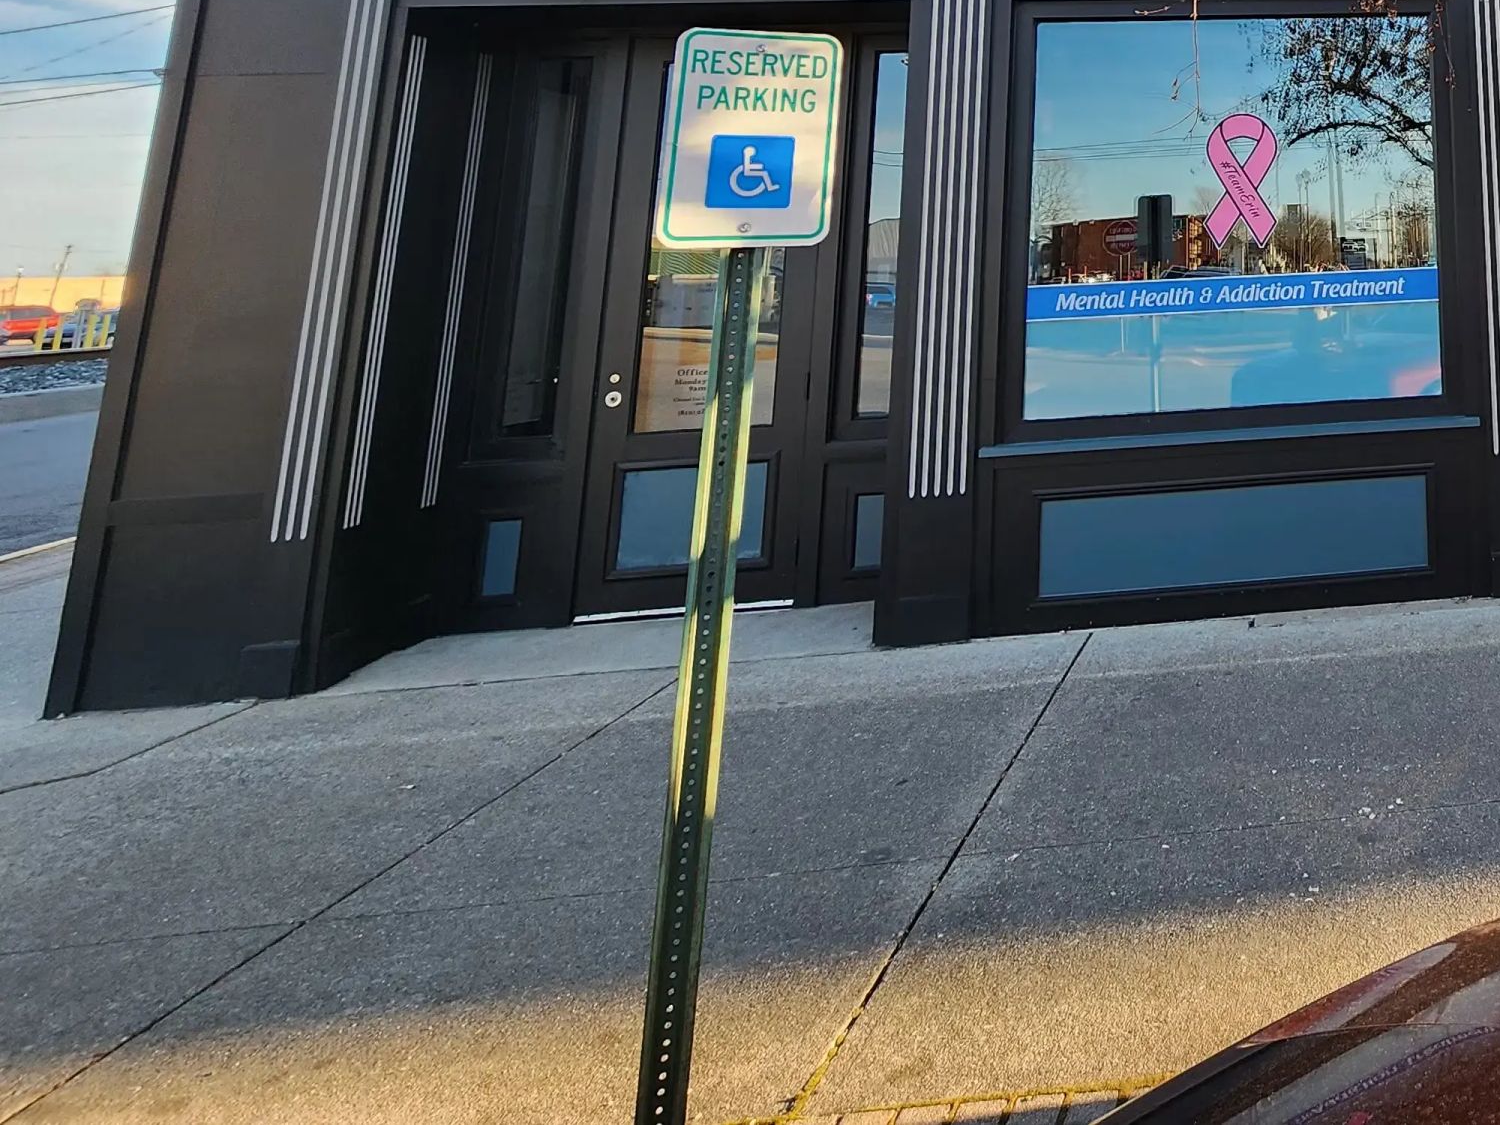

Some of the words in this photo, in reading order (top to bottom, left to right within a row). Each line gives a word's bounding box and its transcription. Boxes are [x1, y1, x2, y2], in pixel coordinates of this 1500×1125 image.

[690, 48, 828, 79] RESERVED
[696, 84, 817, 113] PARKING
[1219, 161, 1260, 218] #TeamErin
[1055, 289, 1126, 311] Mental
[1129, 287, 1194, 308] Health
[1199, 287, 1213, 304] &
[1216, 281, 1305, 303] Addiction
[1310, 277, 1405, 298] Treatment
